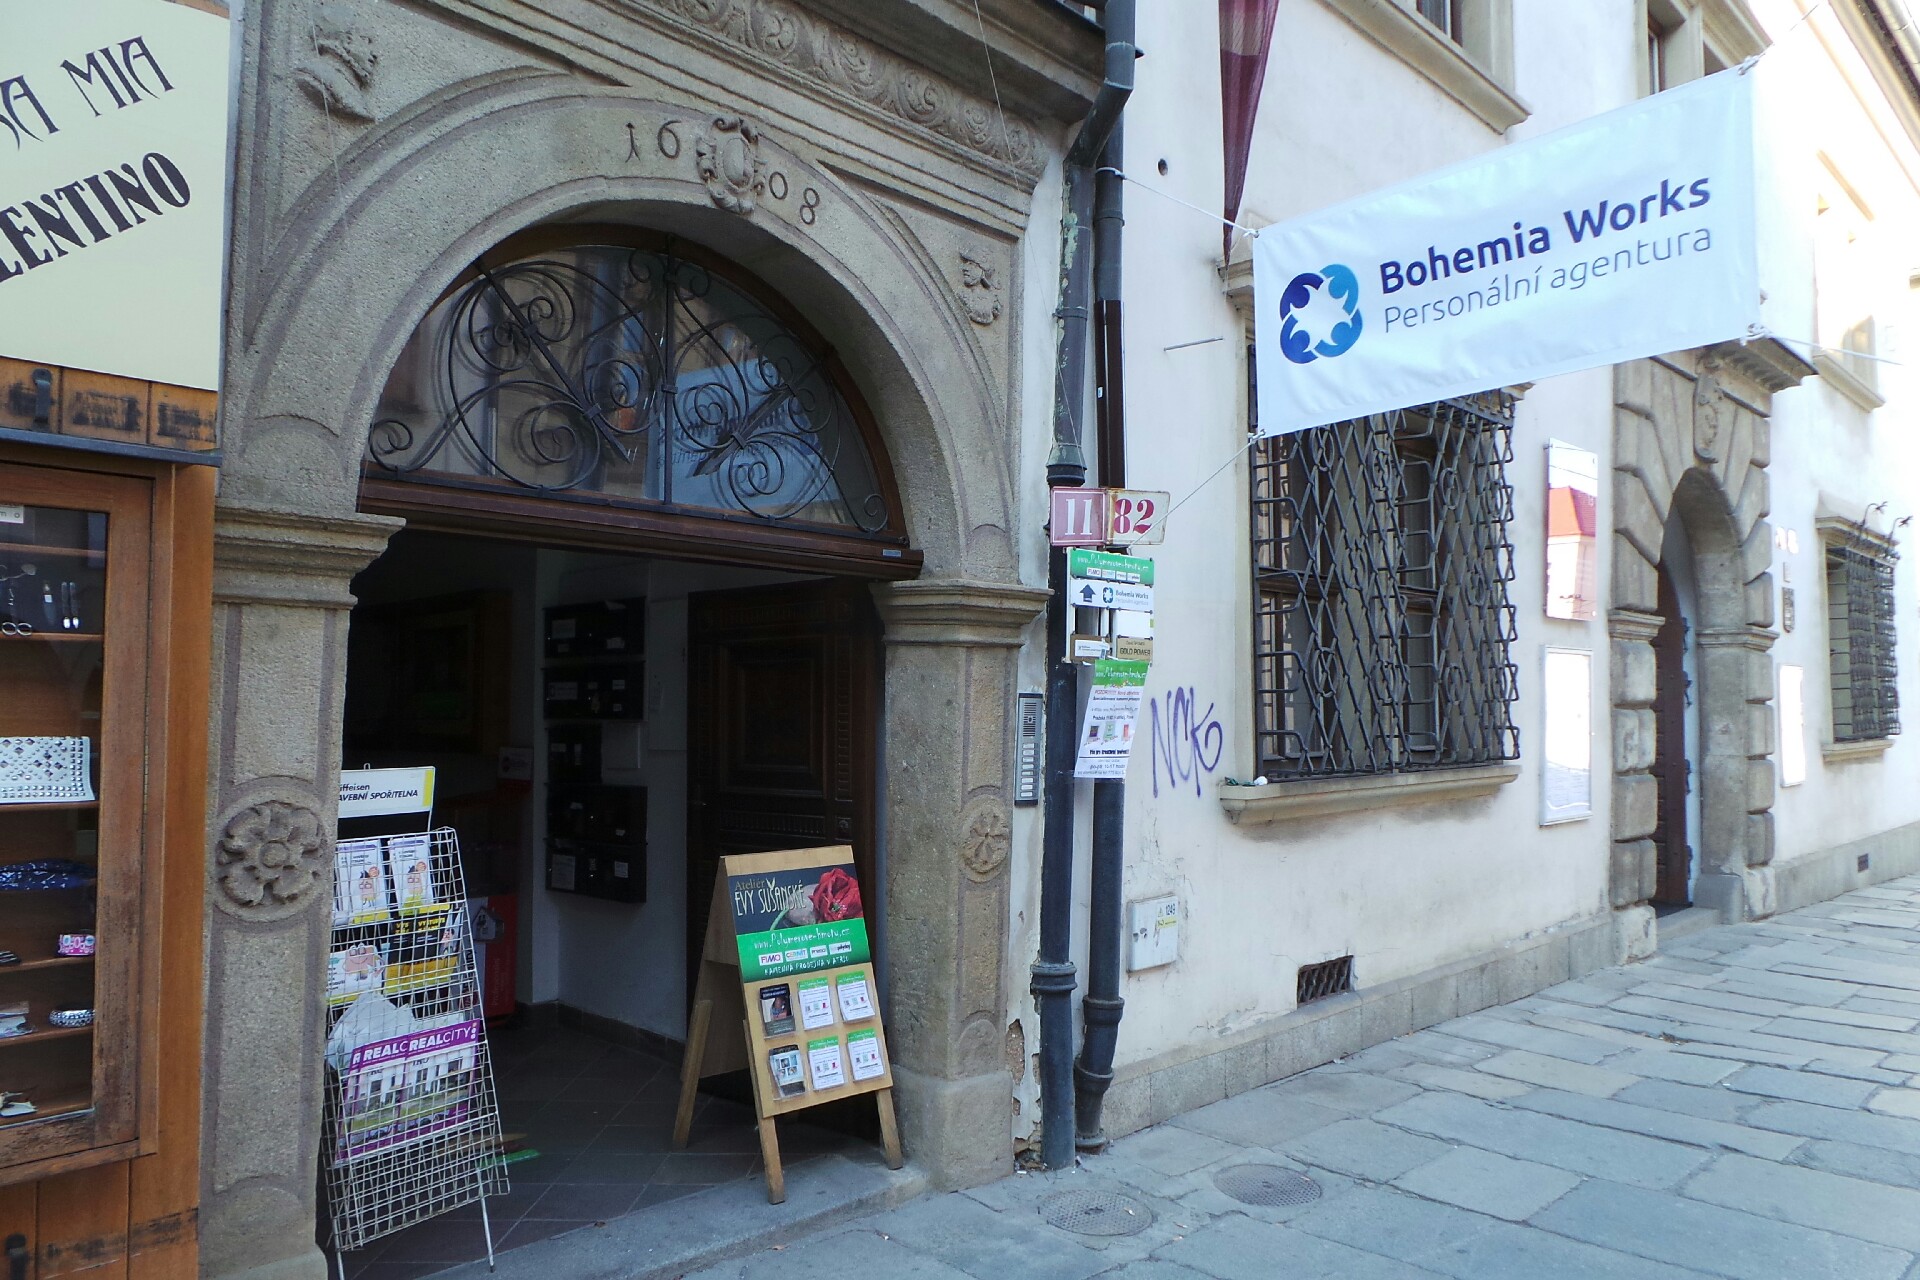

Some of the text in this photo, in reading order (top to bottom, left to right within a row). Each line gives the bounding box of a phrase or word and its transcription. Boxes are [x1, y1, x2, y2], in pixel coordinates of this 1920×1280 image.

[60, 36, 174, 117] MIA
[1380, 176, 1711, 295] Bohemia Works
[1384, 227, 1711, 333] Personální agentura
[1065, 499, 1093, 536] 11
[1113, 499, 1155, 535] 82
[1115, 589, 1135, 598] Bohemia
[1134, 649, 1151, 657] POWER
[369, 788, 418, 800] SPOŘITELNA
[735, 878, 766, 891] Ateliér
[735, 877, 807, 916] EVY SUŠANSKÉ
[760, 954, 782, 964] FIMO
[408, 1026, 472, 1052] REALCITY
